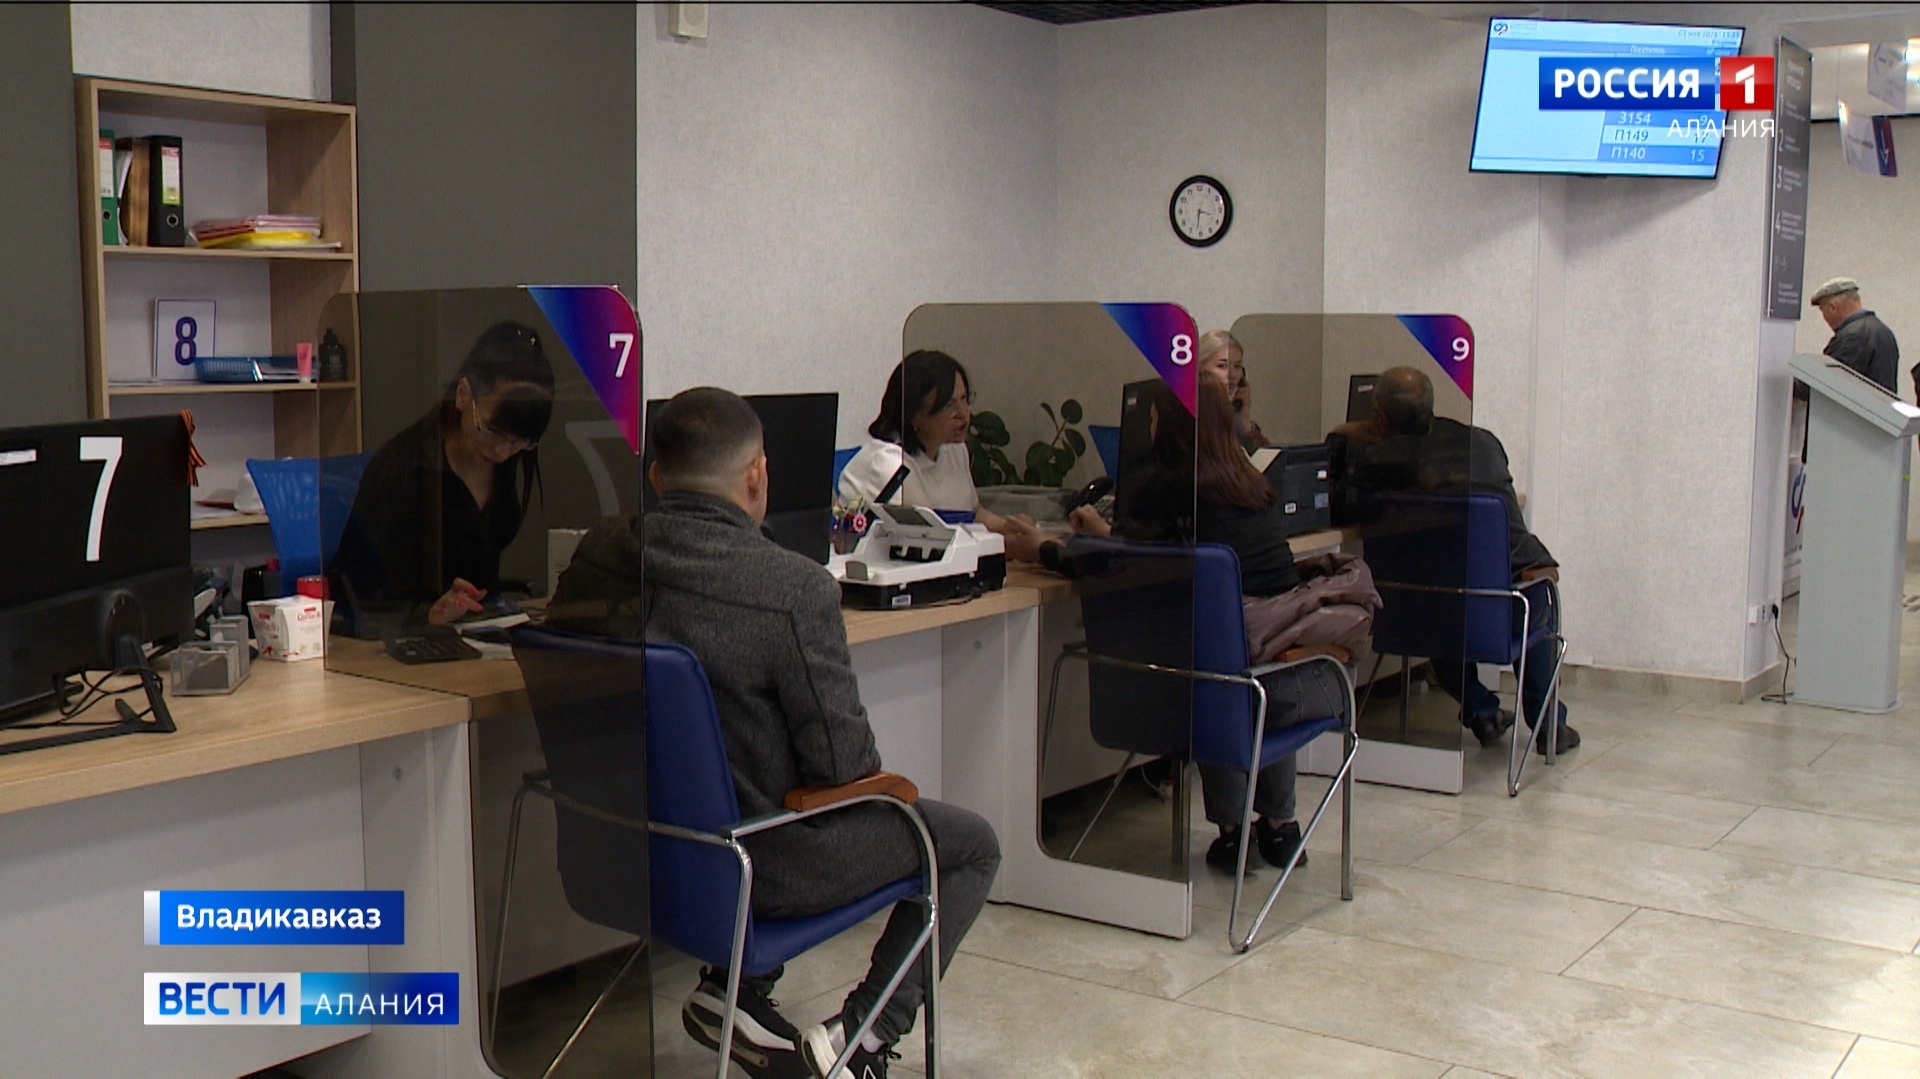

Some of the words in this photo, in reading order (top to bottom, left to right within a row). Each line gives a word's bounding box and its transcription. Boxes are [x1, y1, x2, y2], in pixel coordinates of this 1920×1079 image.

[1614, 129, 1649, 142] П149
[1611, 147, 1646, 160] П140
[1690, 149, 1705, 162] 15
[174, 317, 198, 366] 8
[609, 333, 634, 378] 7
[1171, 334, 1193, 366] 8
[1452, 337, 1470, 361] 9
[80, 436, 123, 561] 7
